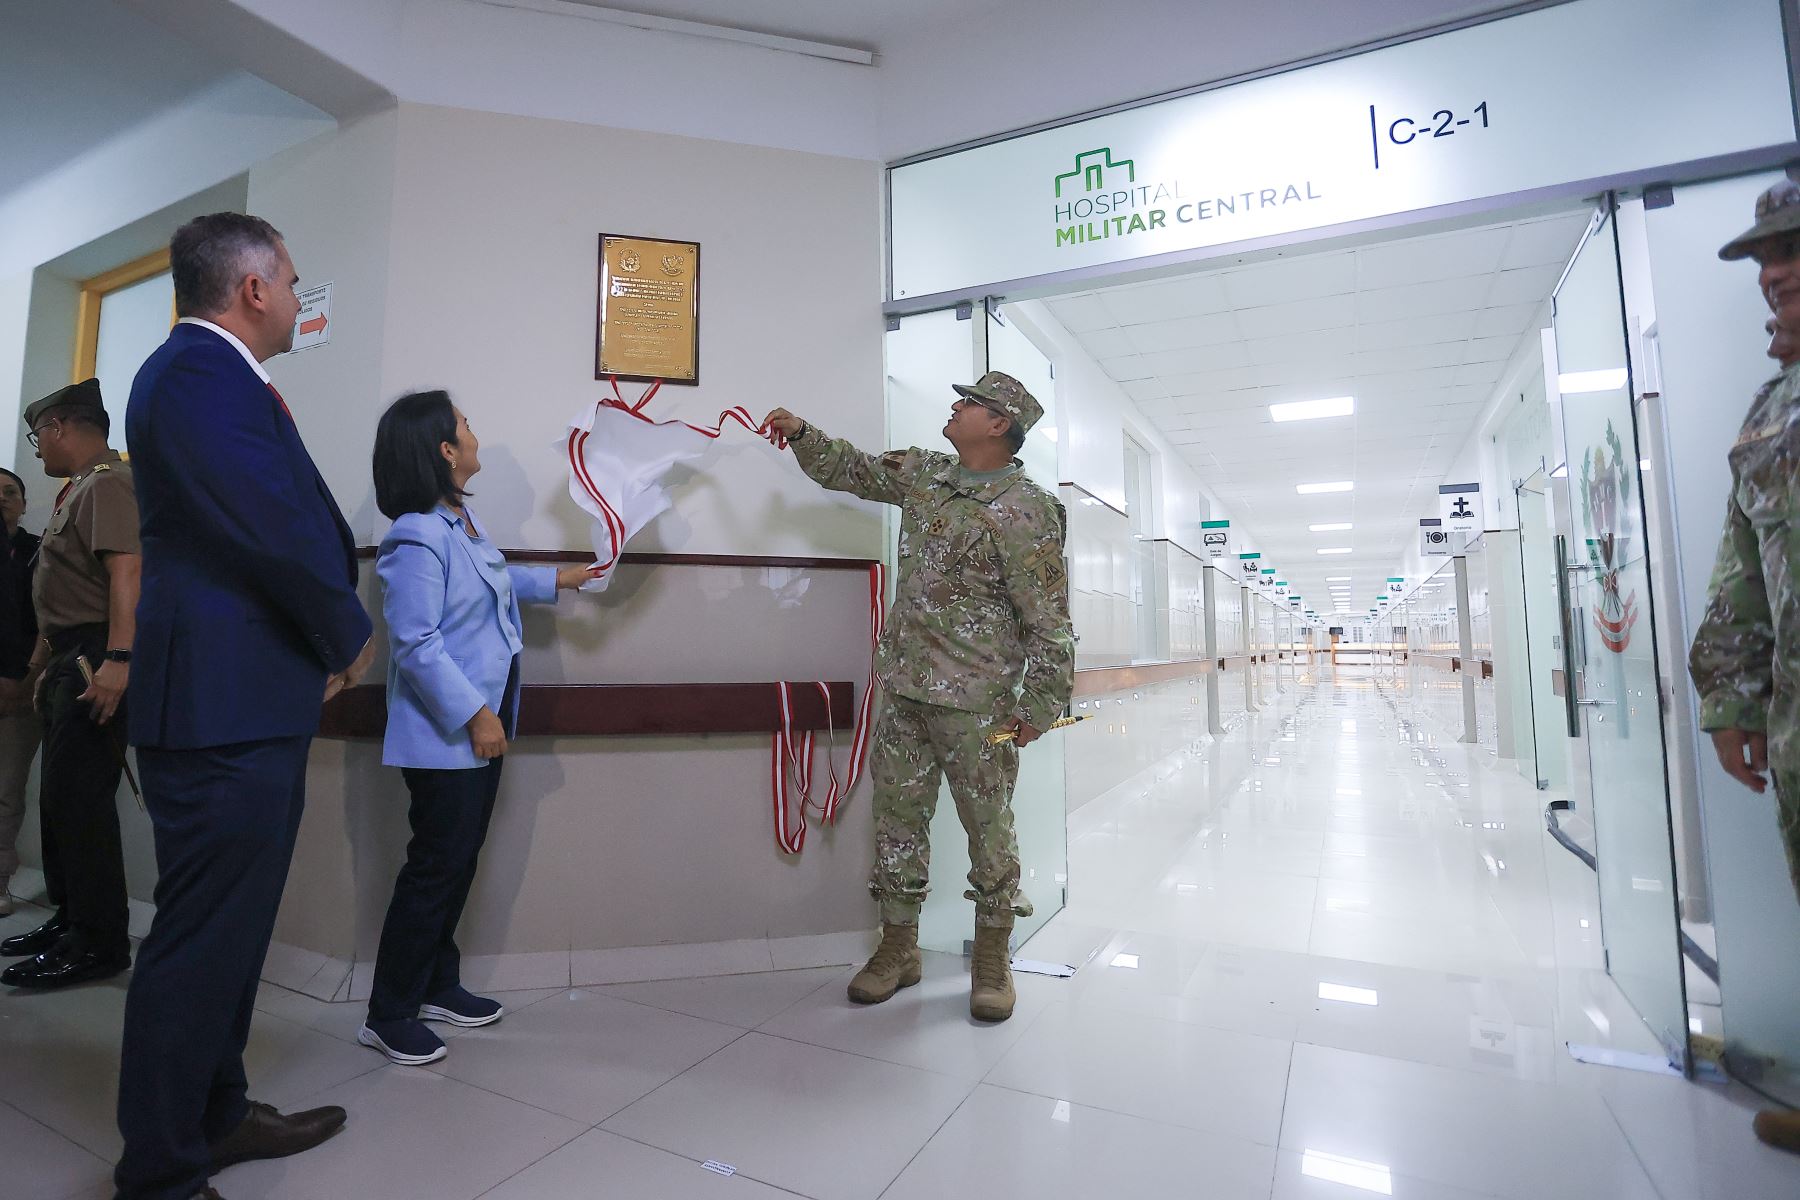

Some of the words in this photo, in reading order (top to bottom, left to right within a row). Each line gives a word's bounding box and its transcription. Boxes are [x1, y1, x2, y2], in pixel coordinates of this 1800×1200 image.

[1388, 101, 1490, 145] C-2-1
[1055, 180, 1188, 222] HOSPITAL
[1056, 209, 1167, 247] MILITAR
[1176, 181, 1323, 223] CENTRAL
